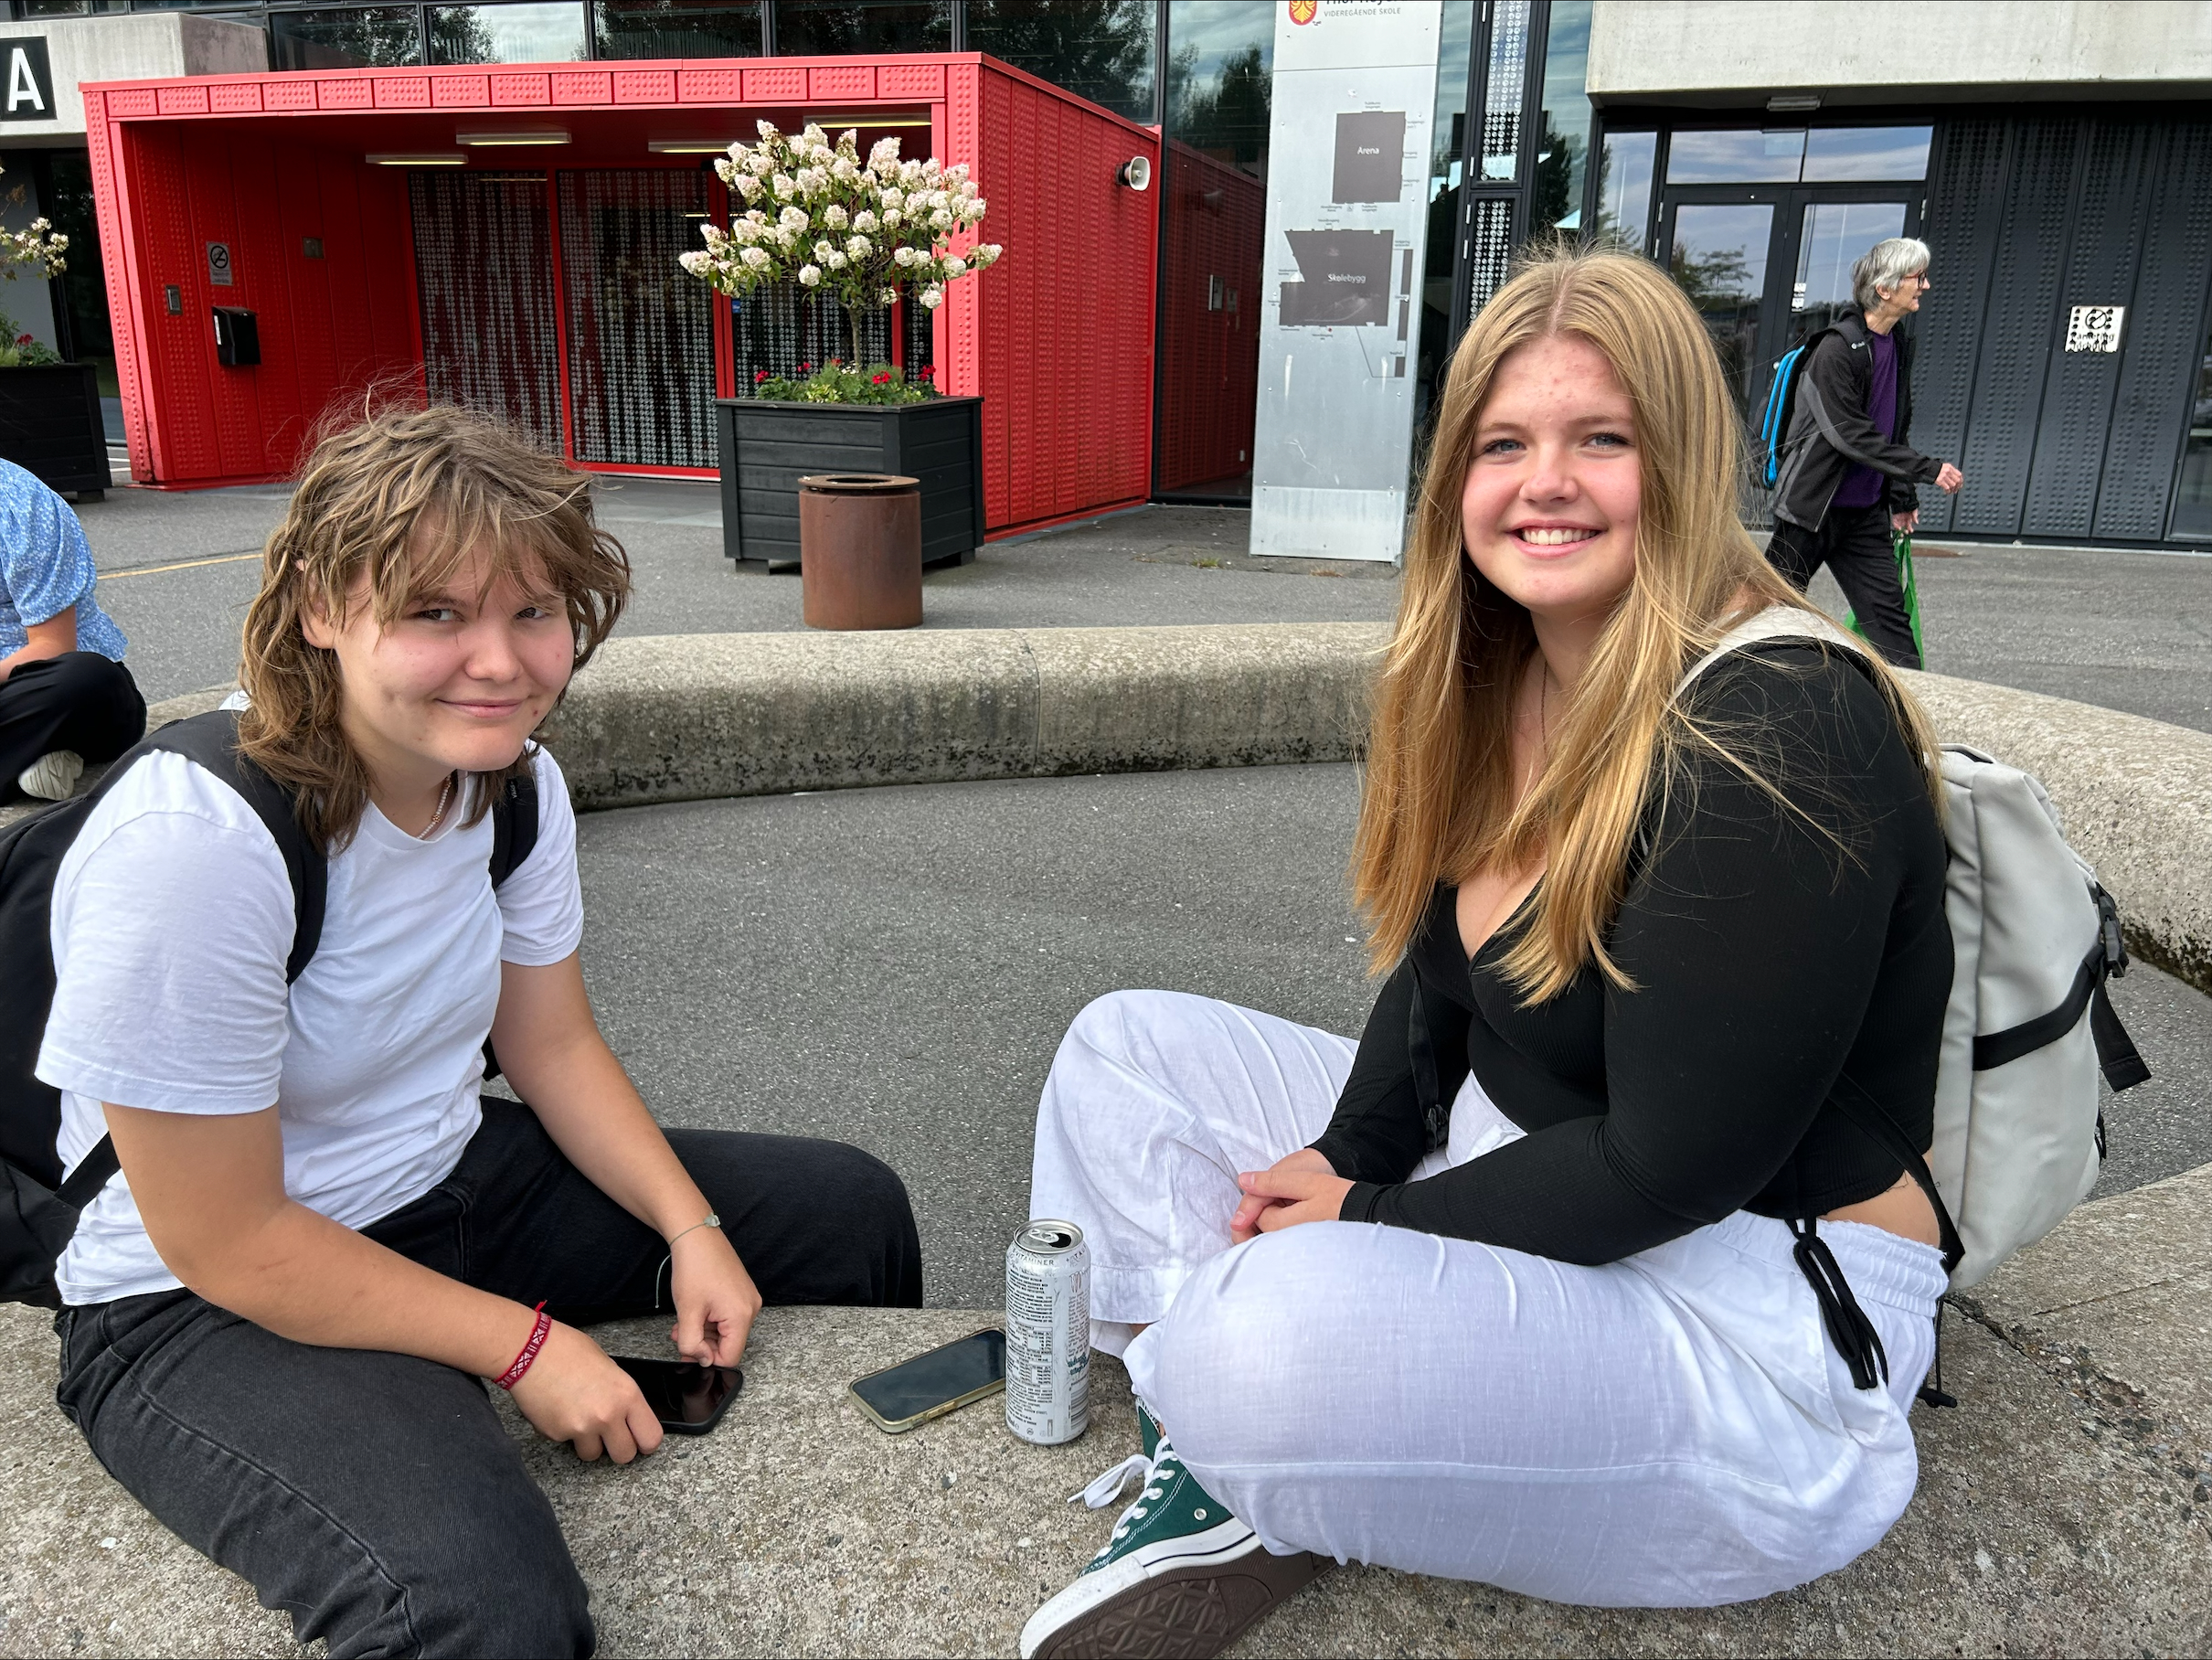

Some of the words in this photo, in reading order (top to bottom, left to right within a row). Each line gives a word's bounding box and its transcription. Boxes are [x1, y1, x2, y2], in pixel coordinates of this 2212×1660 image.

[8, 48, 45, 112] A
[1357, 146, 1379, 154] Arena
[1327, 273, 1366, 283] Skolebygg
